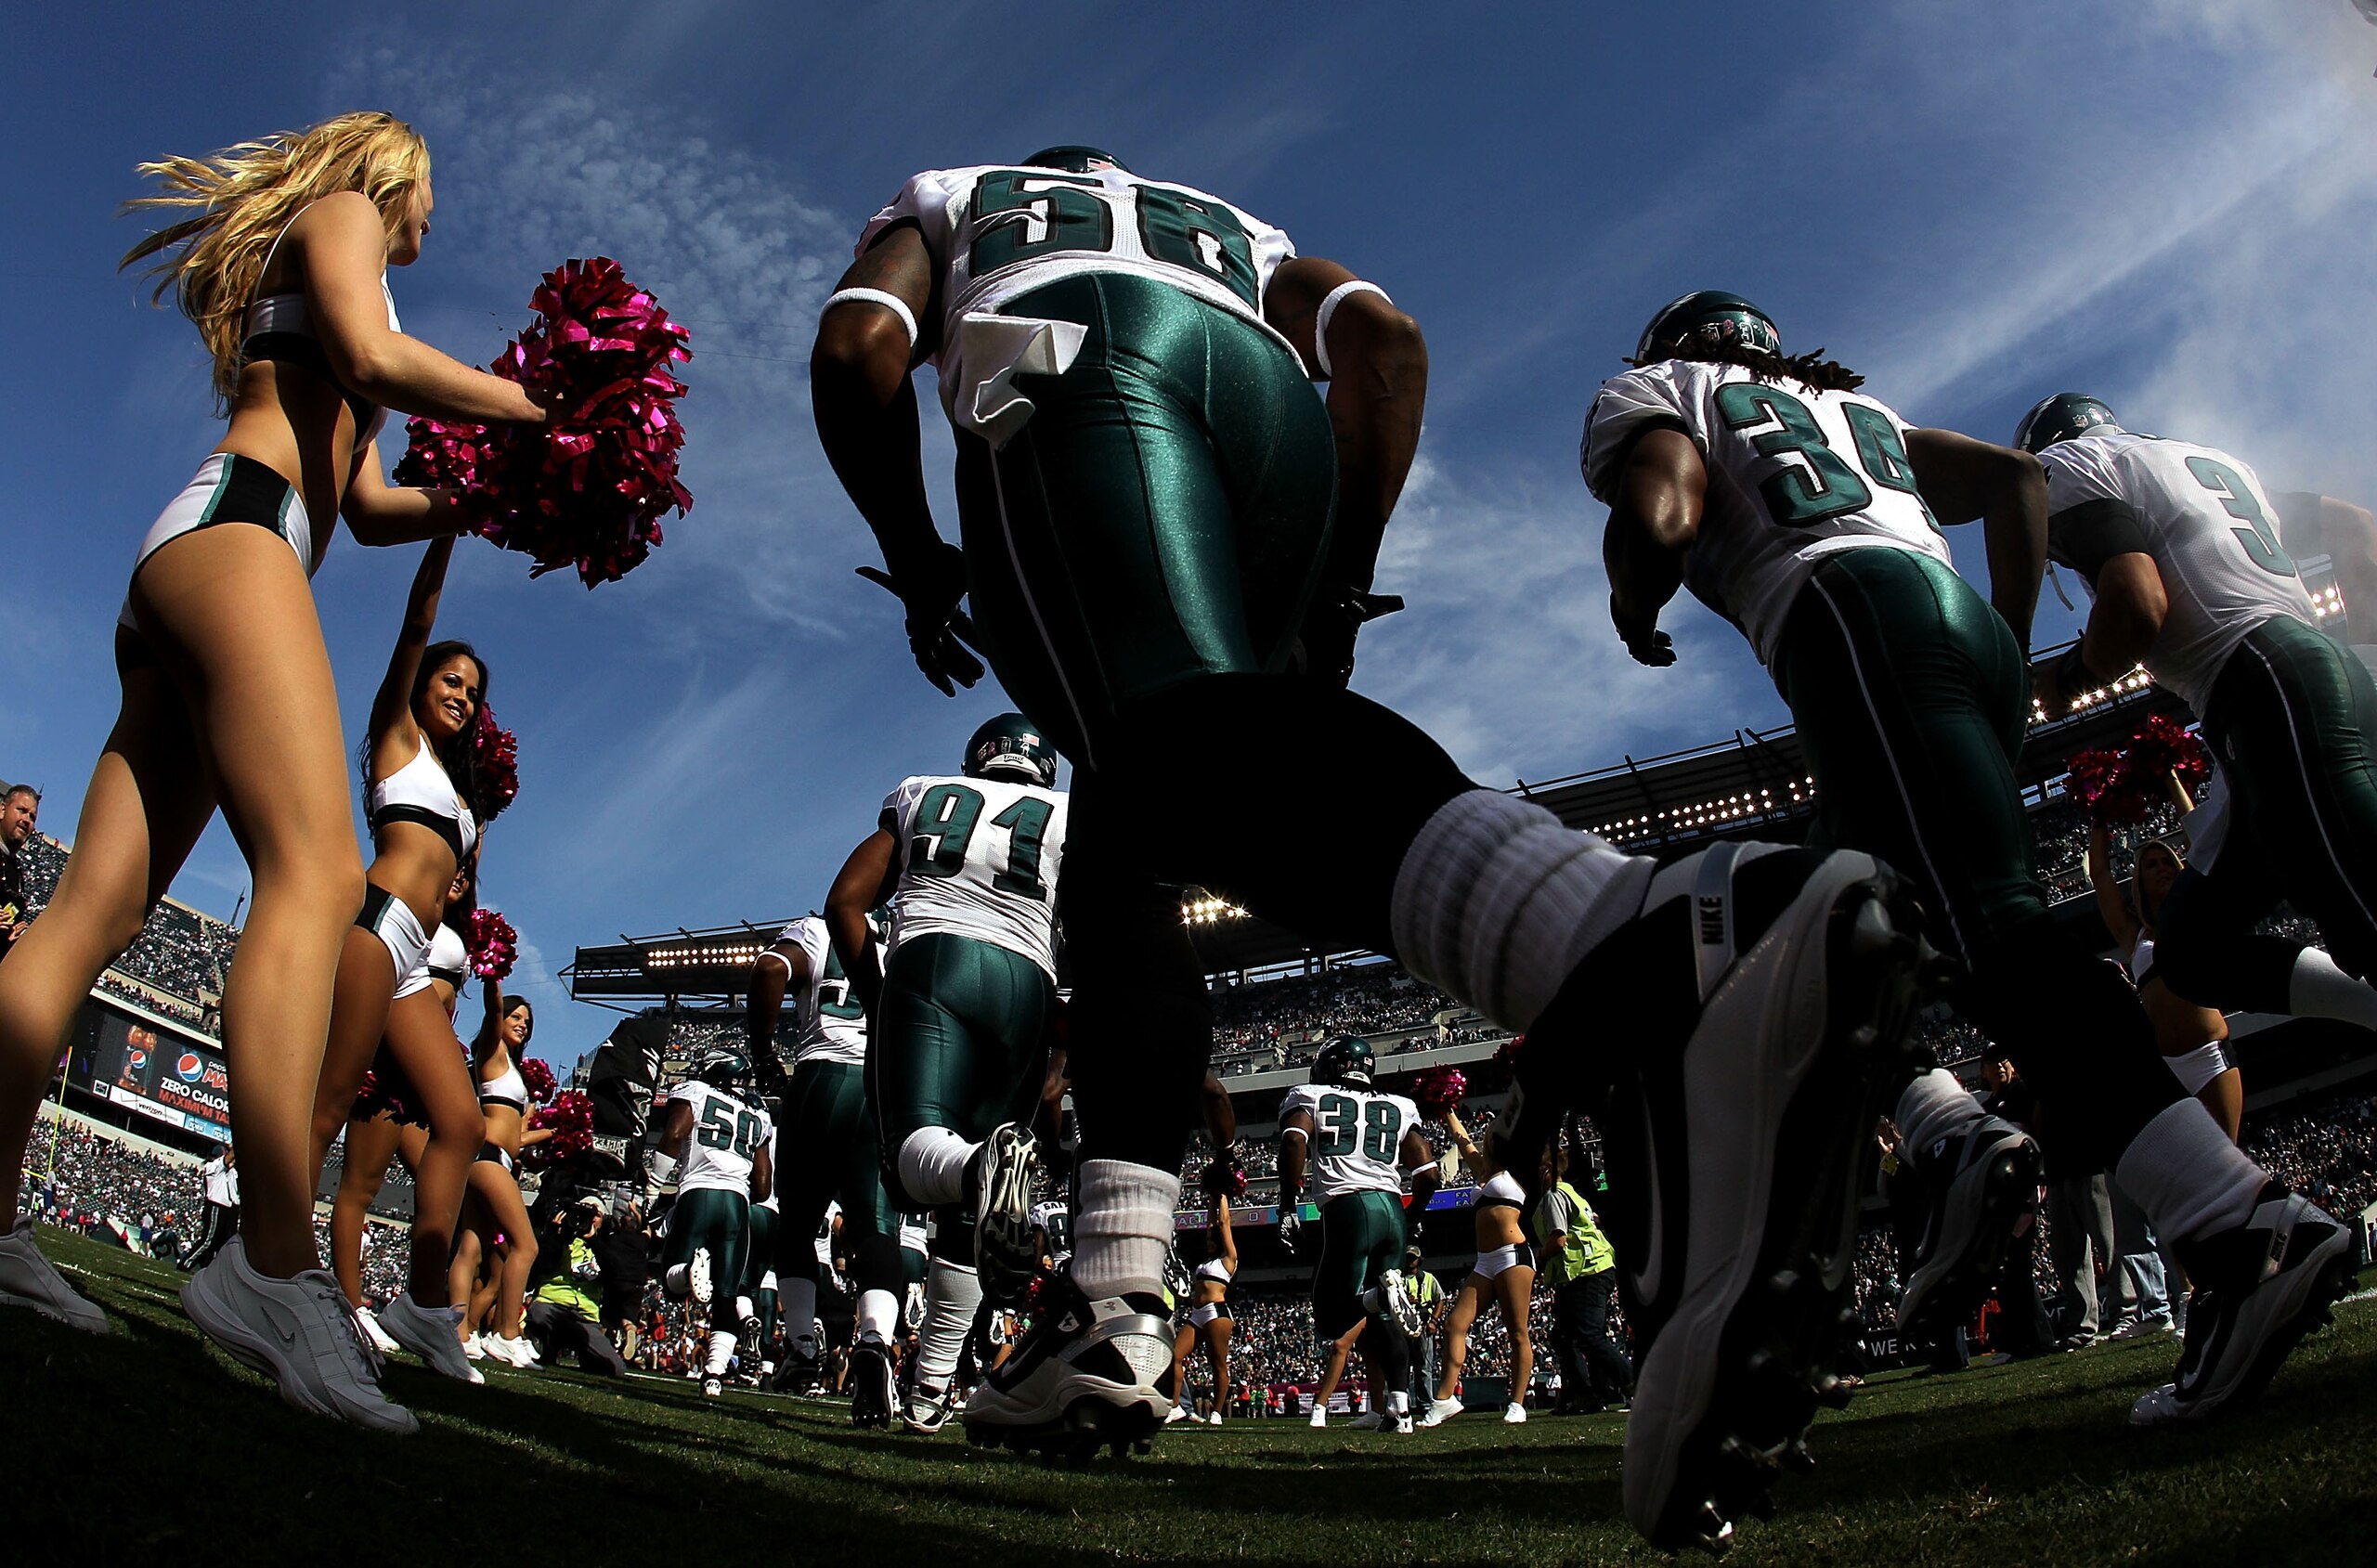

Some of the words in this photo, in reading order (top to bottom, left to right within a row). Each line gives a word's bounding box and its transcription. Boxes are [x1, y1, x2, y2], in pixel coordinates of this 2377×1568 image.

[2184, 456, 2296, 577] 3
[906, 783, 1055, 902] 91
[1699, 896, 1723, 945] NIKE
[138, 1102, 163, 1116] verizon
[158, 1089, 213, 1118] MAXIMUM
[161, 1077, 191, 1097] ZERO
[697, 1094, 763, 1160] 50
[1317, 1093, 1402, 1165] 38
[1871, 1339, 1898, 1356] WE
